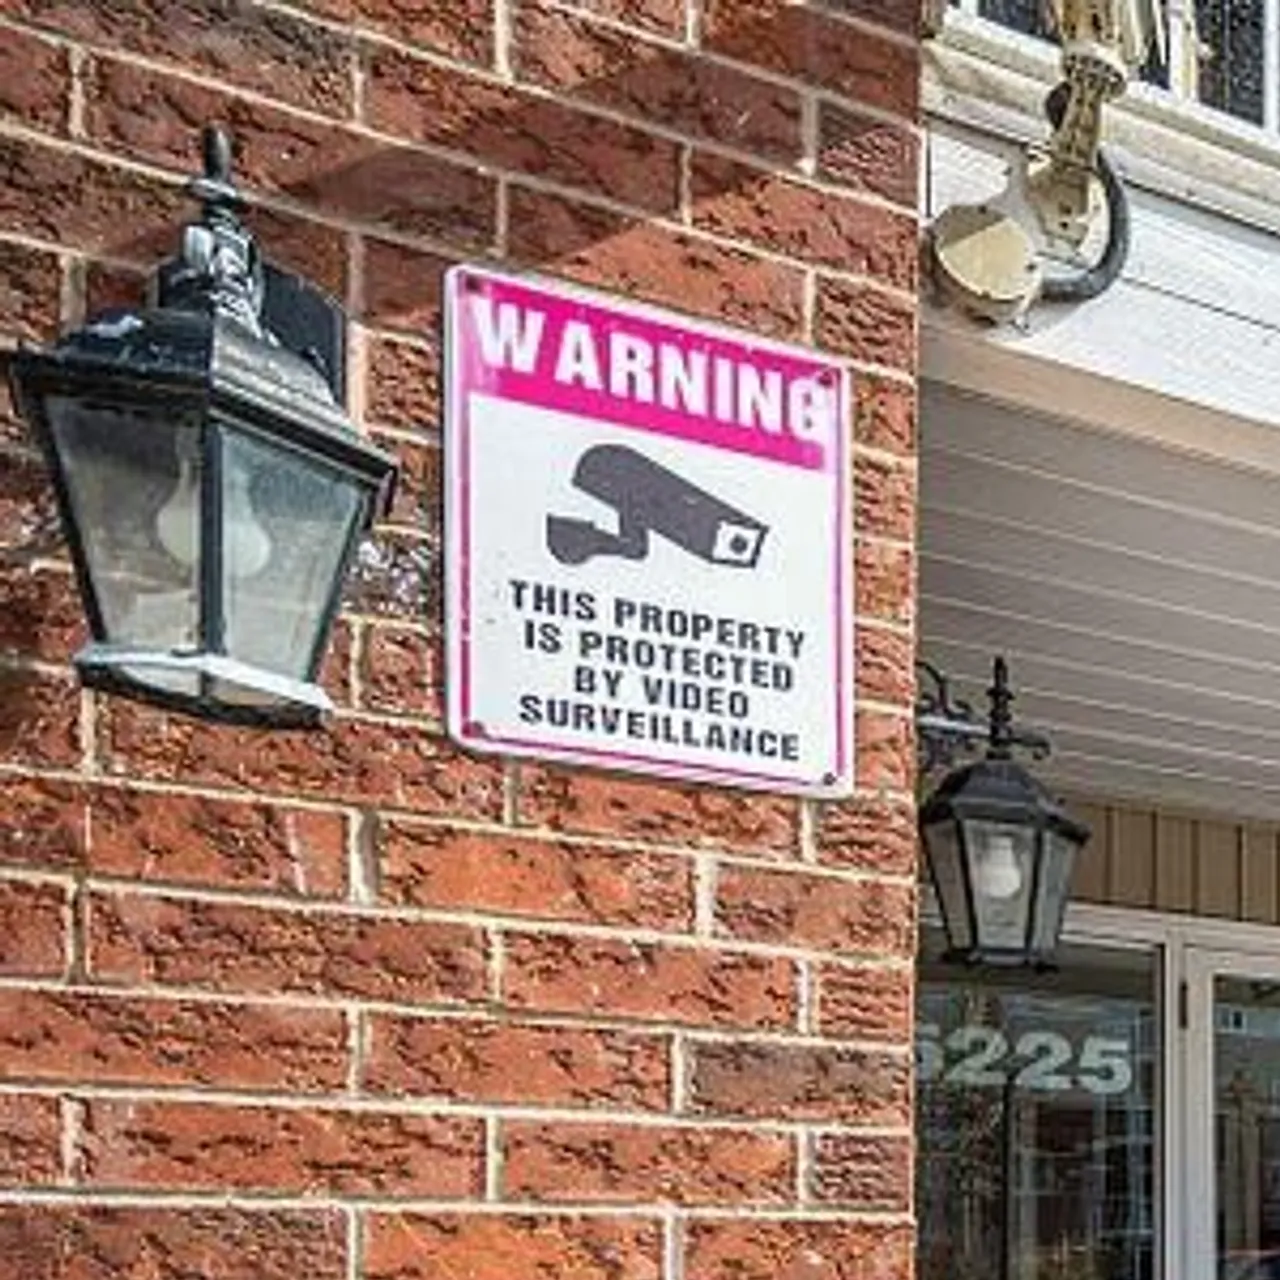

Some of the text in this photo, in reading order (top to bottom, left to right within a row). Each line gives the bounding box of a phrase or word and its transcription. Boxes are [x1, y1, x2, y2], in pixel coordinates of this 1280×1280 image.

[469, 298, 828, 443] WARNING
[509, 579, 804, 658] THIS PROPERTY
[524, 620, 793, 692] IS PROTECTED
[518, 694, 801, 762] SURVEILLANCE
[573, 666, 750, 719] BY VIDEO
